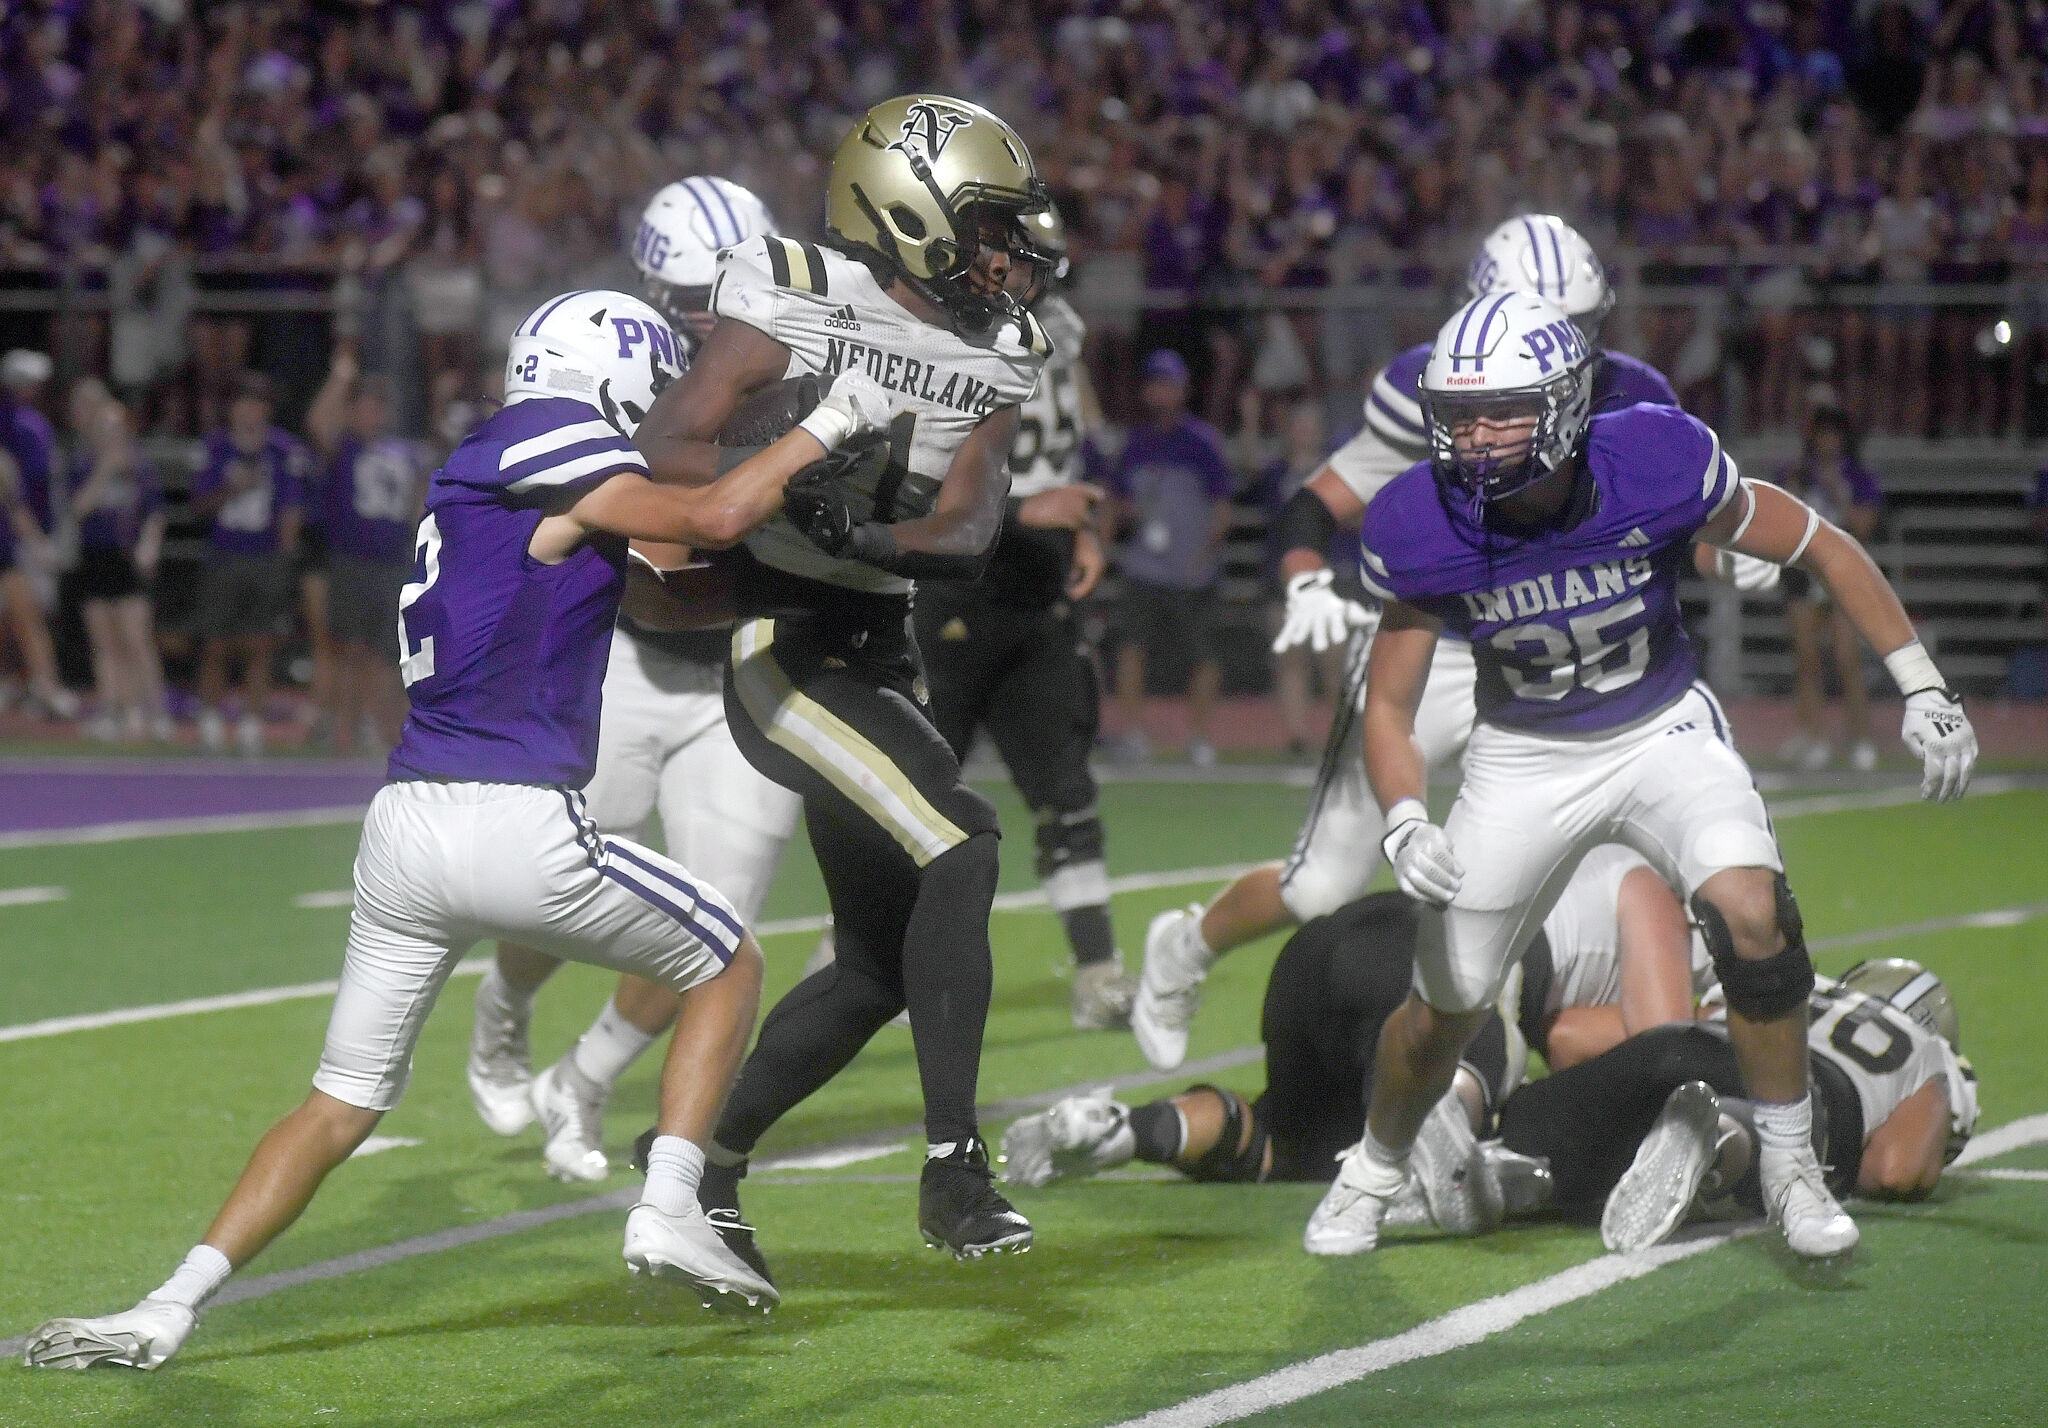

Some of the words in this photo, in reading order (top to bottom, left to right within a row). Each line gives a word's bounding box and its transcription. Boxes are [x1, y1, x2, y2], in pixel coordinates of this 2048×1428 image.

[638, 219, 671, 271] NG
[824, 317, 862, 332] adidas
[523, 354, 539, 383] 2
[823, 338, 998, 416] NEDERLAND
[1446, 376, 1486, 386] Riddell
[1463, 553, 1653, 623] INDIANS
[1490, 594, 1651, 702] 35
